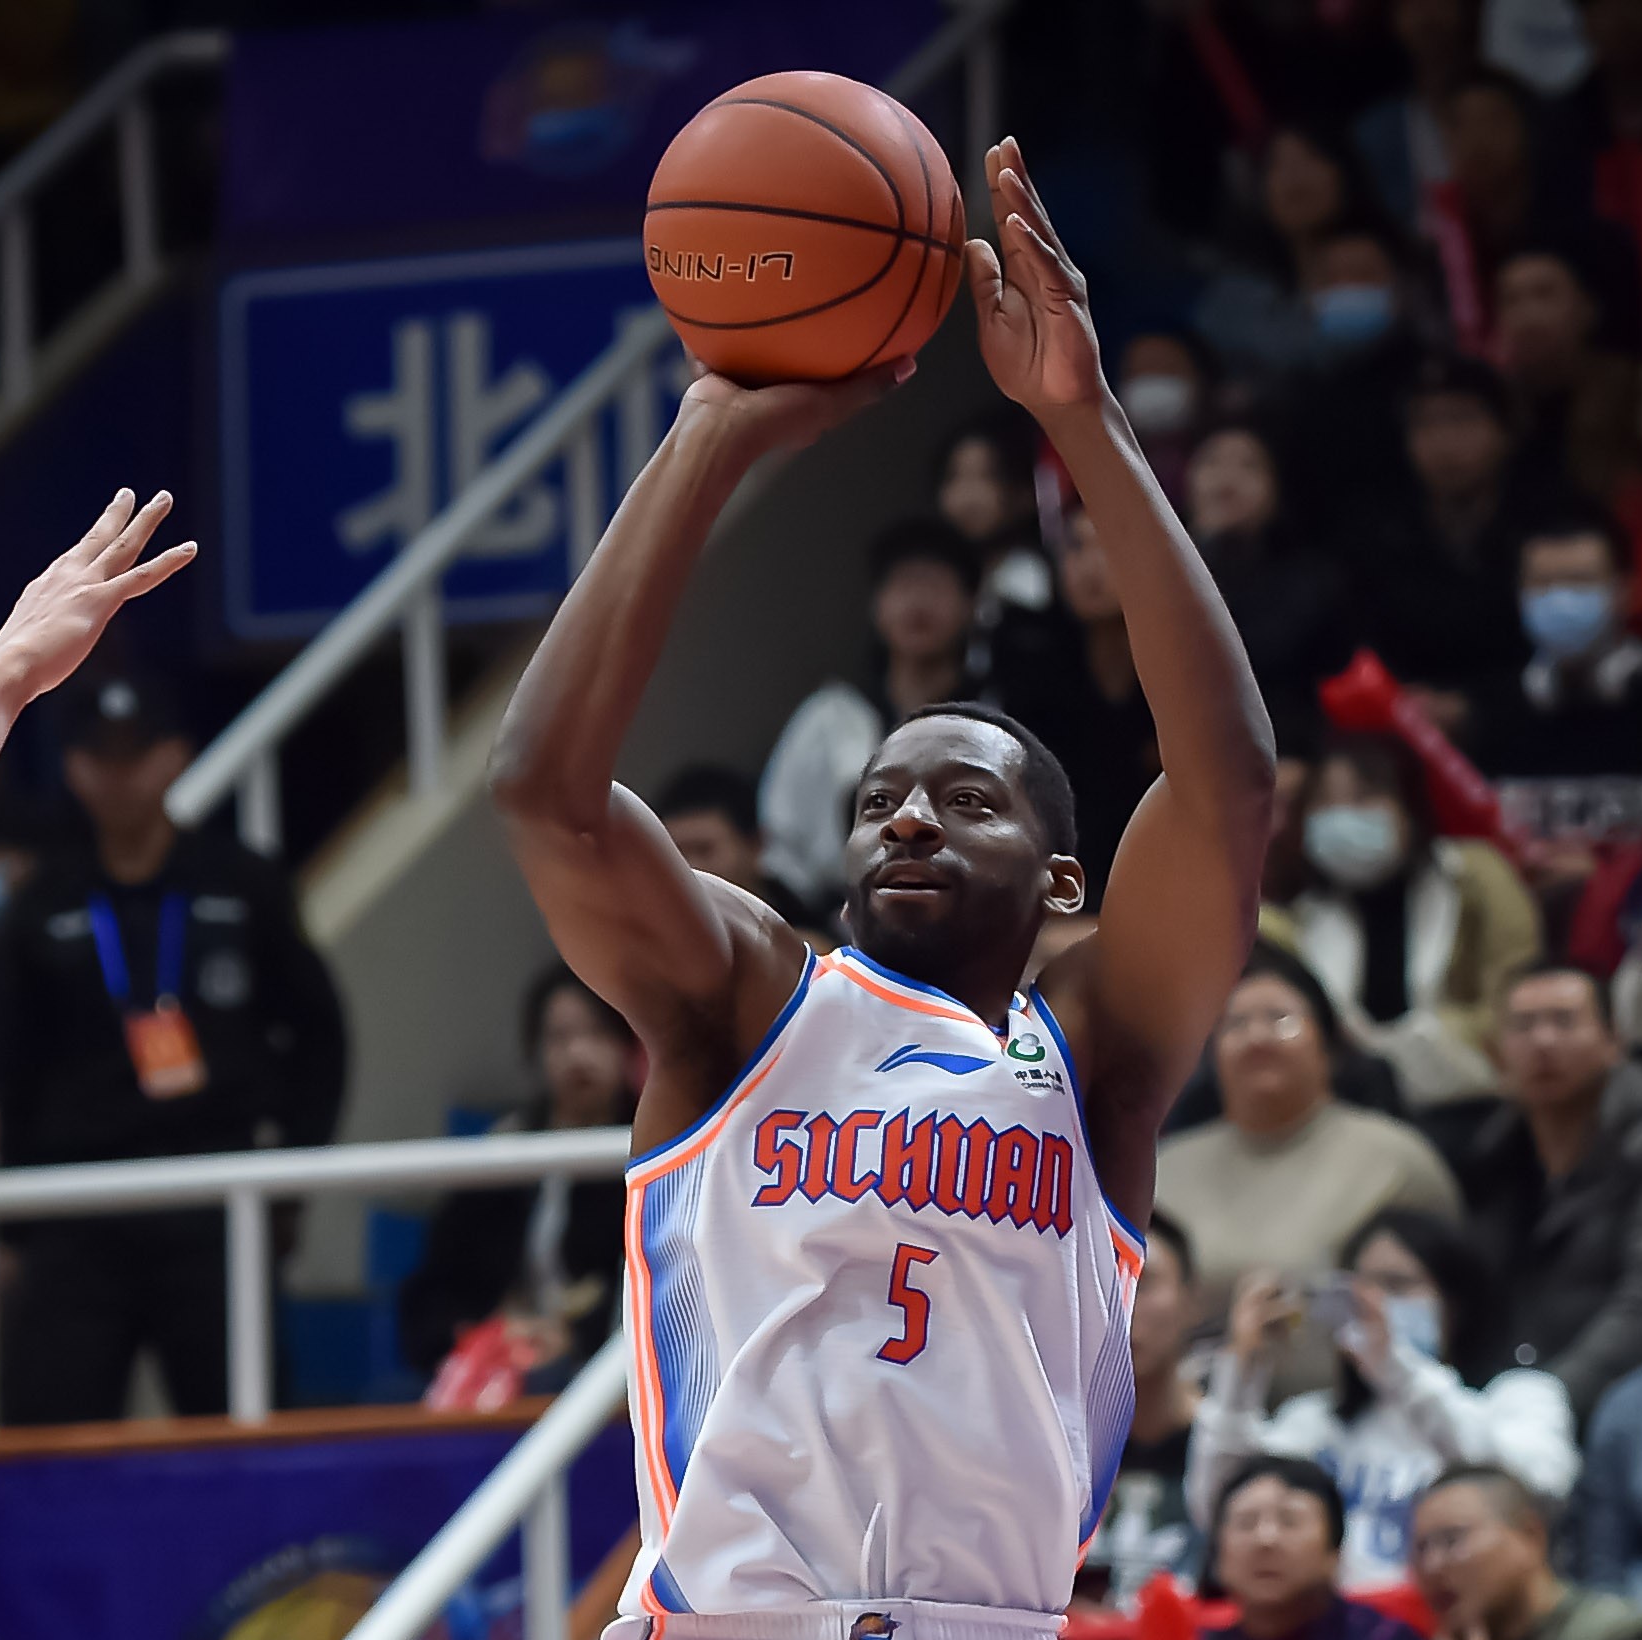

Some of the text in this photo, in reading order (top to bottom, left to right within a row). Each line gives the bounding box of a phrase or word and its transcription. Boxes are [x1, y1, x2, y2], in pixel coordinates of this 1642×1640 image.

[648, 244, 794, 282] LI-NING
[751, 1106, 1075, 1239] SICHUAN
[875, 1243, 939, 1366] 5
